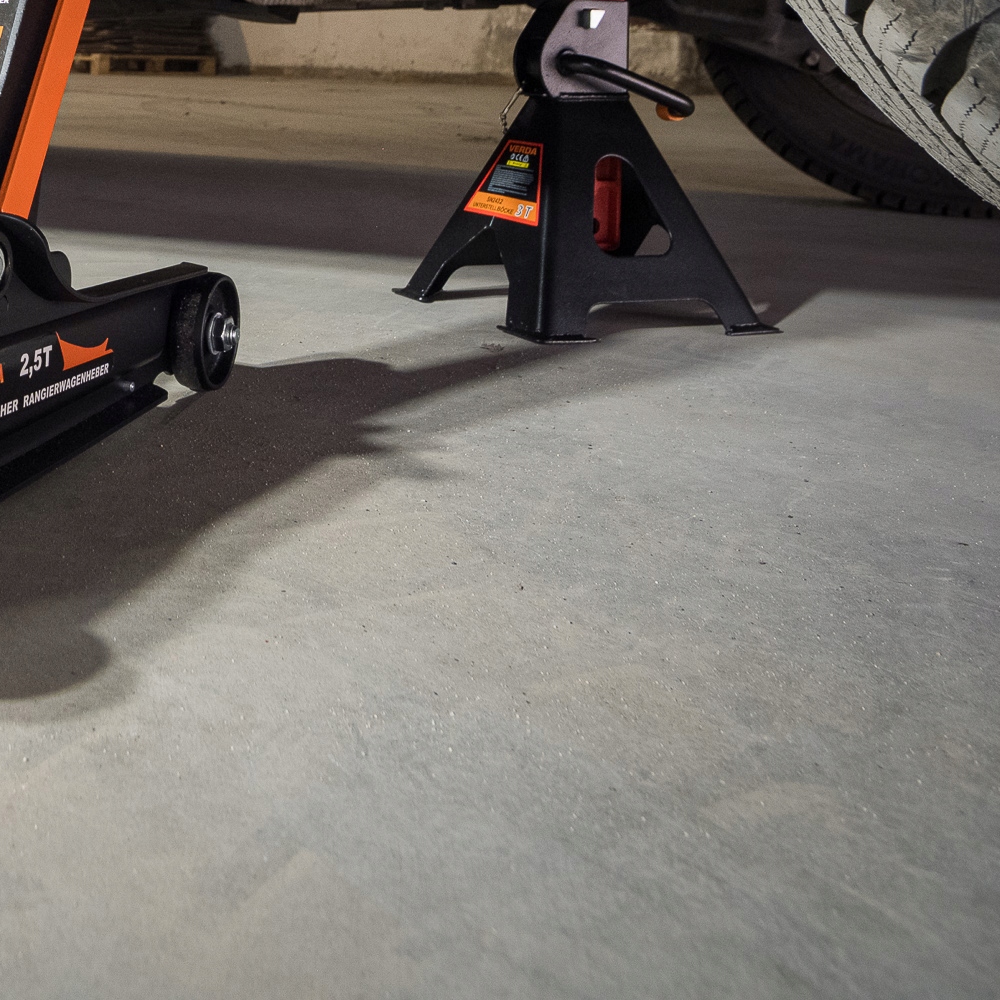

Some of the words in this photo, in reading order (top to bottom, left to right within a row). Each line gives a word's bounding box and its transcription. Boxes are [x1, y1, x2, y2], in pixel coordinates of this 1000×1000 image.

[509, 145, 537, 155] VERDA
[19, 345, 53, 379] 2,5T
[23, 362, 110, 408] RANGIERWAGENHEBER
